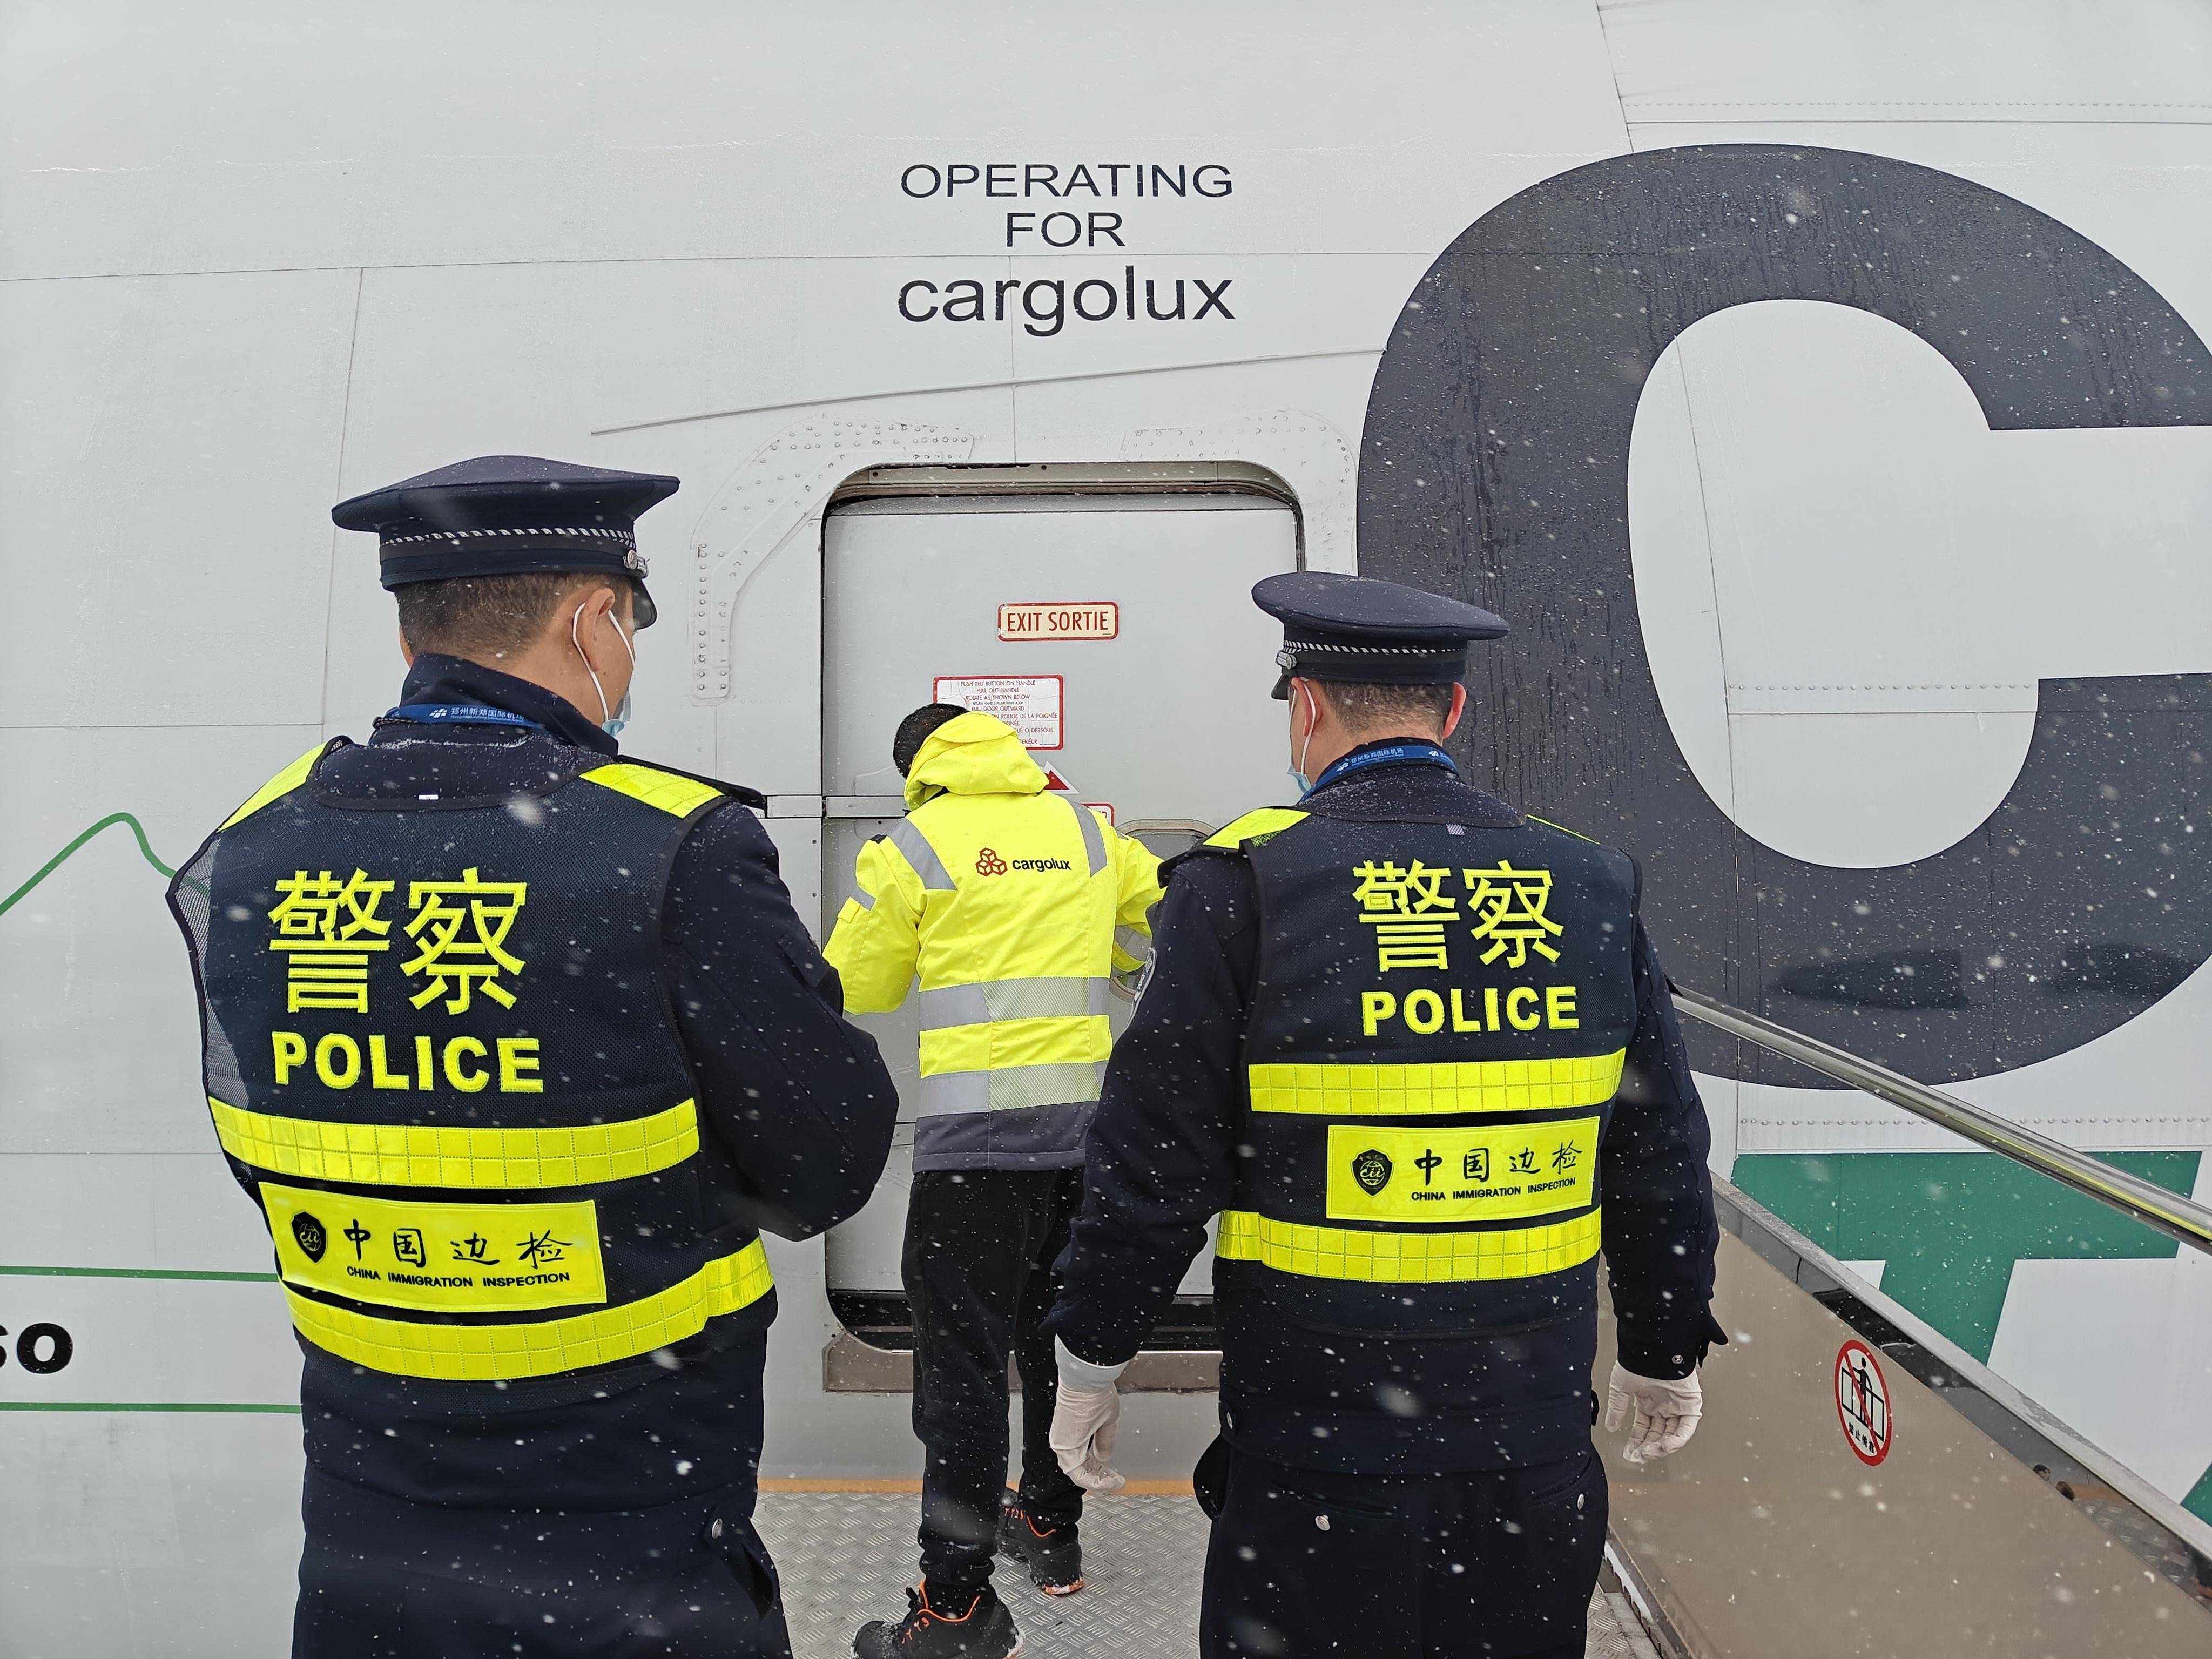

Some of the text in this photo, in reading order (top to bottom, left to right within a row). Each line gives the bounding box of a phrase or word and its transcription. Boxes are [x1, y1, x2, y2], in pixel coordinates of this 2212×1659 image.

[901, 164, 1232, 198] OPERATING
[1006, 211, 1126, 247] FOR
[898, 265, 1236, 337] cargolux
[1007, 611, 1108, 632] EXIT SORTIE
[1012, 858, 1072, 873] cargolux
[1352, 858, 1564, 972] 警察
[268, 867, 528, 1016] 警察
[1361, 986, 1580, 1036] POLICE
[272, 1031, 544, 1093] POLICE
[1413, 1139, 1583, 1186] 中国边检
[1411, 1177, 1576, 1201] CHINA IMMIGRATION INSPECTION
[343, 1218, 573, 1269] 中国边检
[347, 1265, 570, 1287] CHINA IMMIGRATION INSPECTION
[1849, 1422, 1874, 1454] 禁止倚靠
